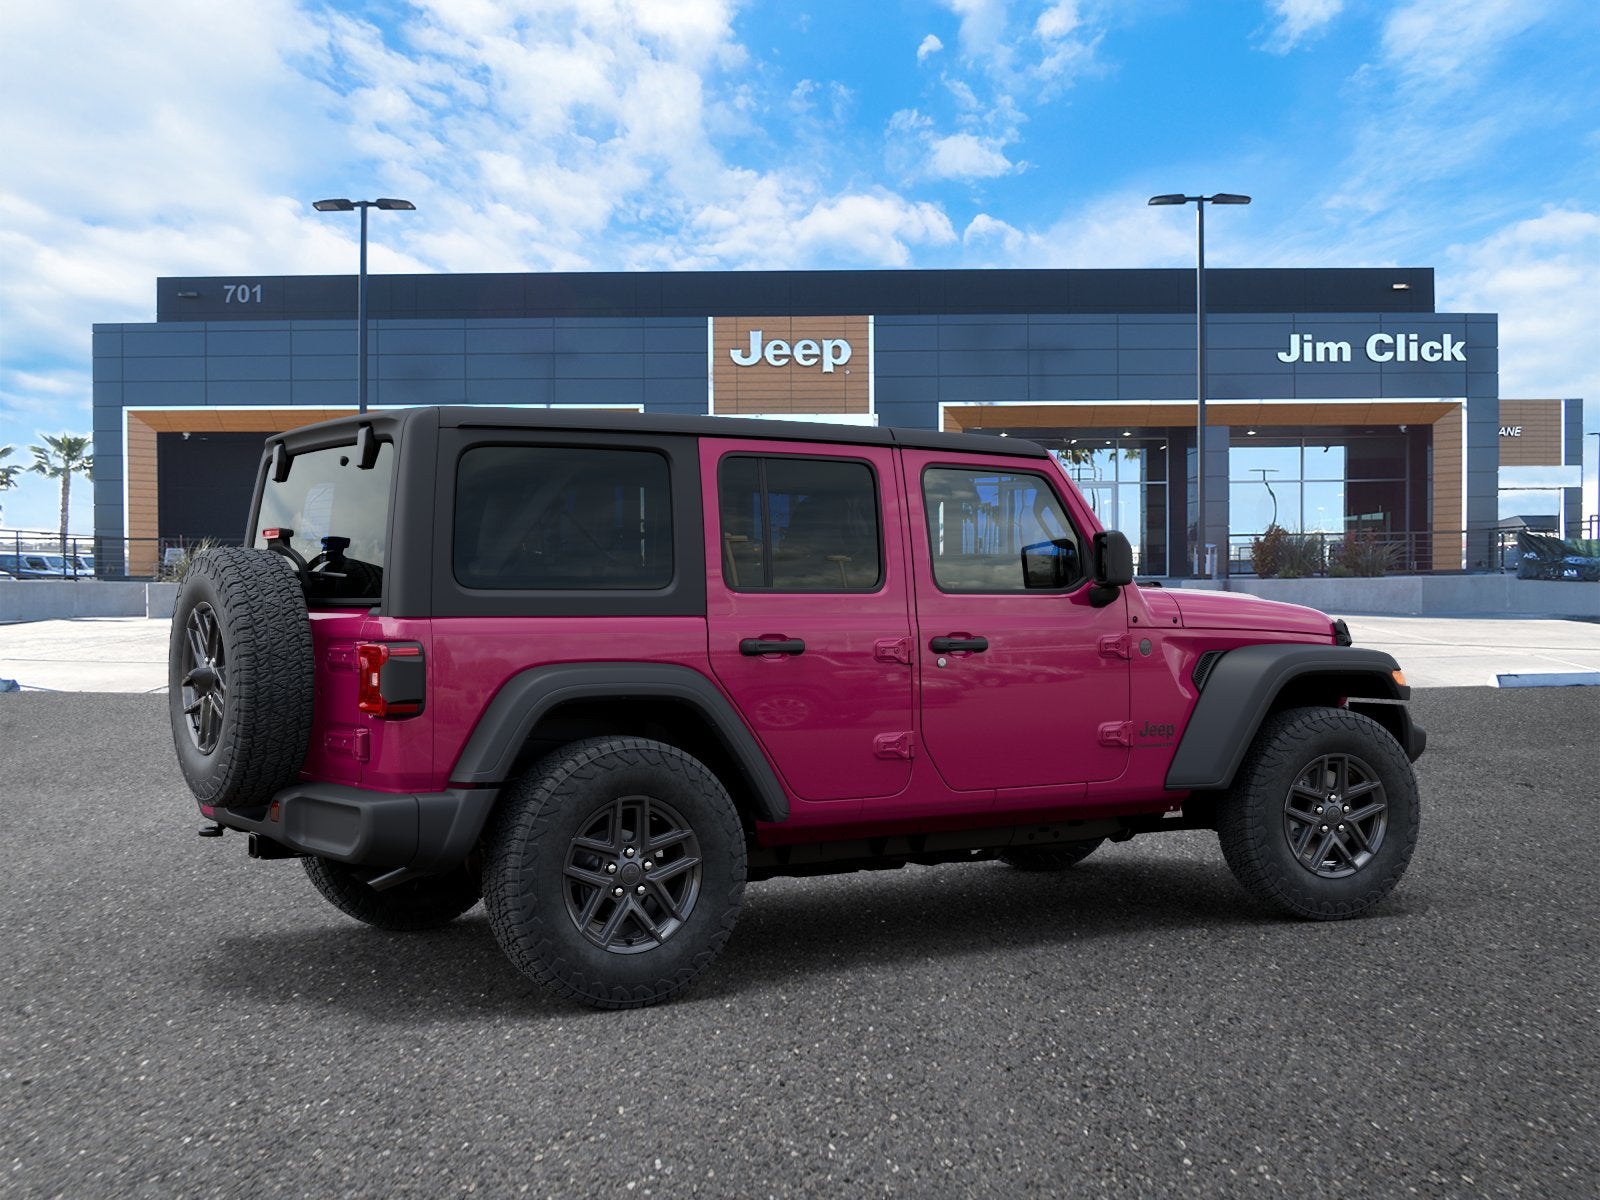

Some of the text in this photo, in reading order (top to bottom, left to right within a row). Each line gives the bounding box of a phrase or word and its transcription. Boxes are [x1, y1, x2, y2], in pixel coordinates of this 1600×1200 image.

[223, 284, 262, 303] 701
[730, 329, 852, 373] Jeep
[1277, 333, 1467, 363] Jim Click
[1138, 720, 1175, 739] Jeep
